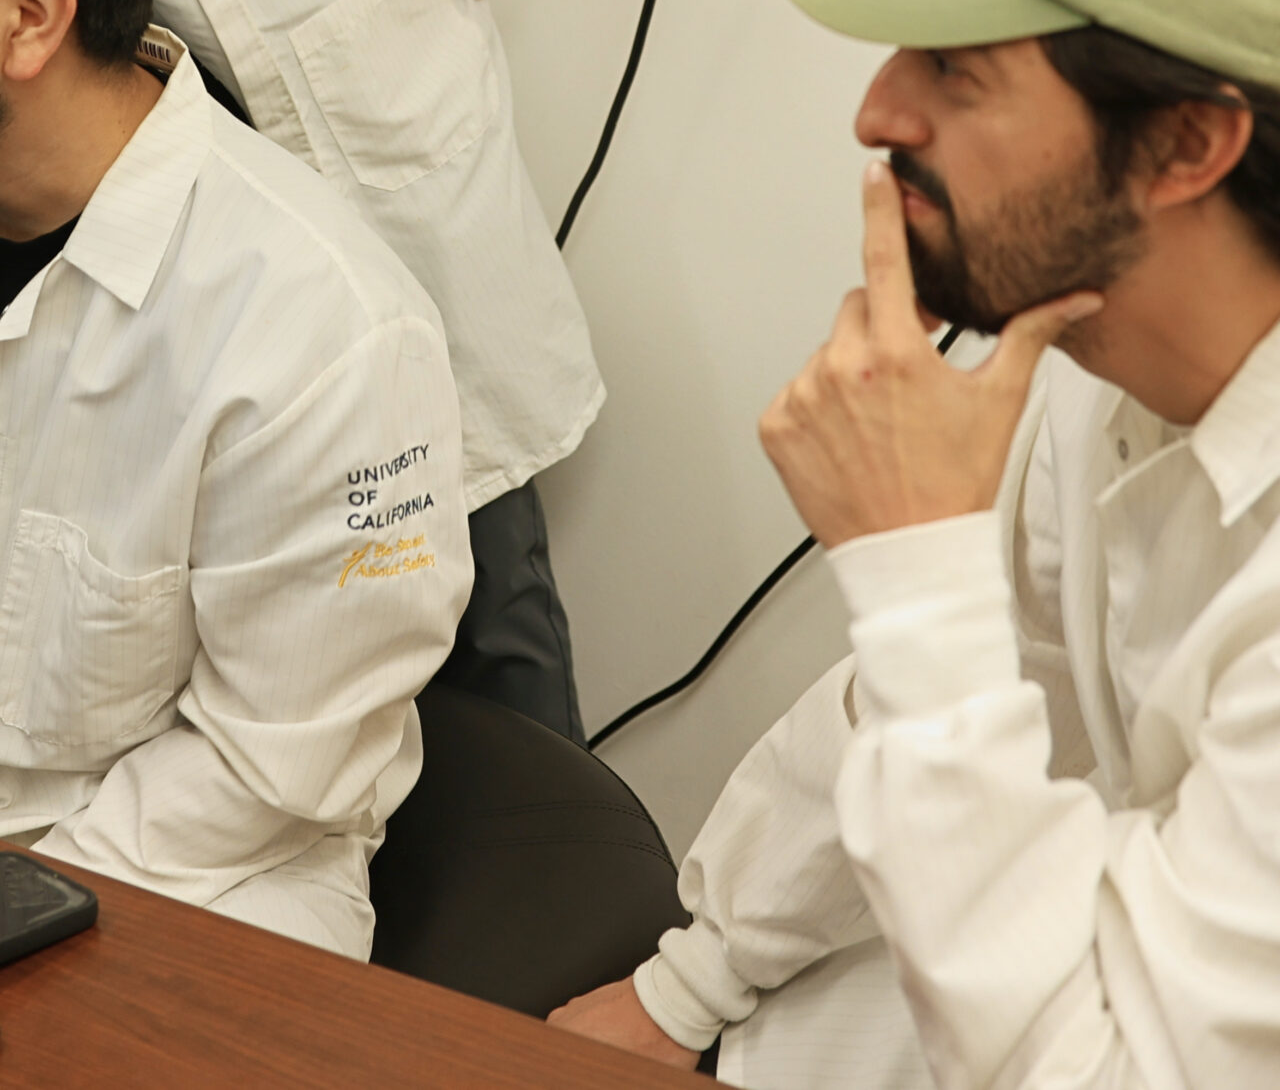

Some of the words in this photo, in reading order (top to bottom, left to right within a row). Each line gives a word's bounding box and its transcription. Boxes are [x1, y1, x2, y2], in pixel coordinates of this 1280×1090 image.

[348, 443, 430, 486] UNIVERSITY
[347, 492, 435, 531] CALIFORNIA
[348, 490, 378, 507] OF
